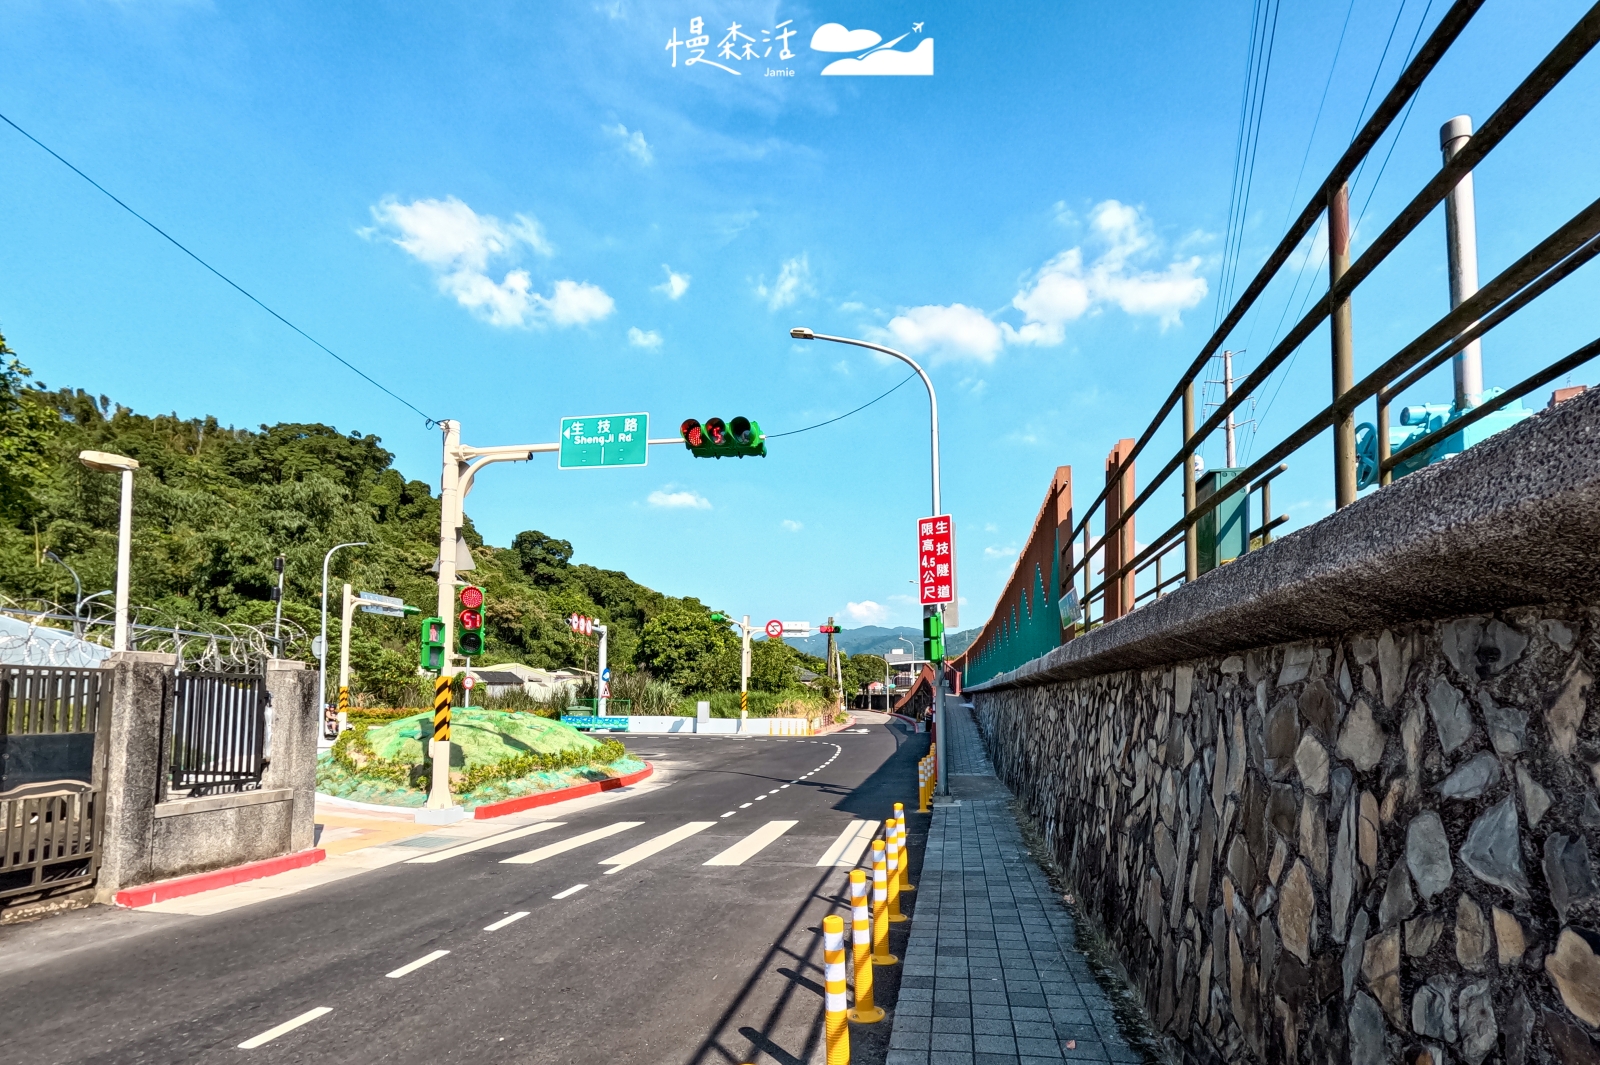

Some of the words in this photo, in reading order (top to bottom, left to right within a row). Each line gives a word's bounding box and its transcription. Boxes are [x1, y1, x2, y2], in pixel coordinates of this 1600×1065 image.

[570, 417, 638, 436] 生技路
[936, 520, 950, 599] 生技隧道
